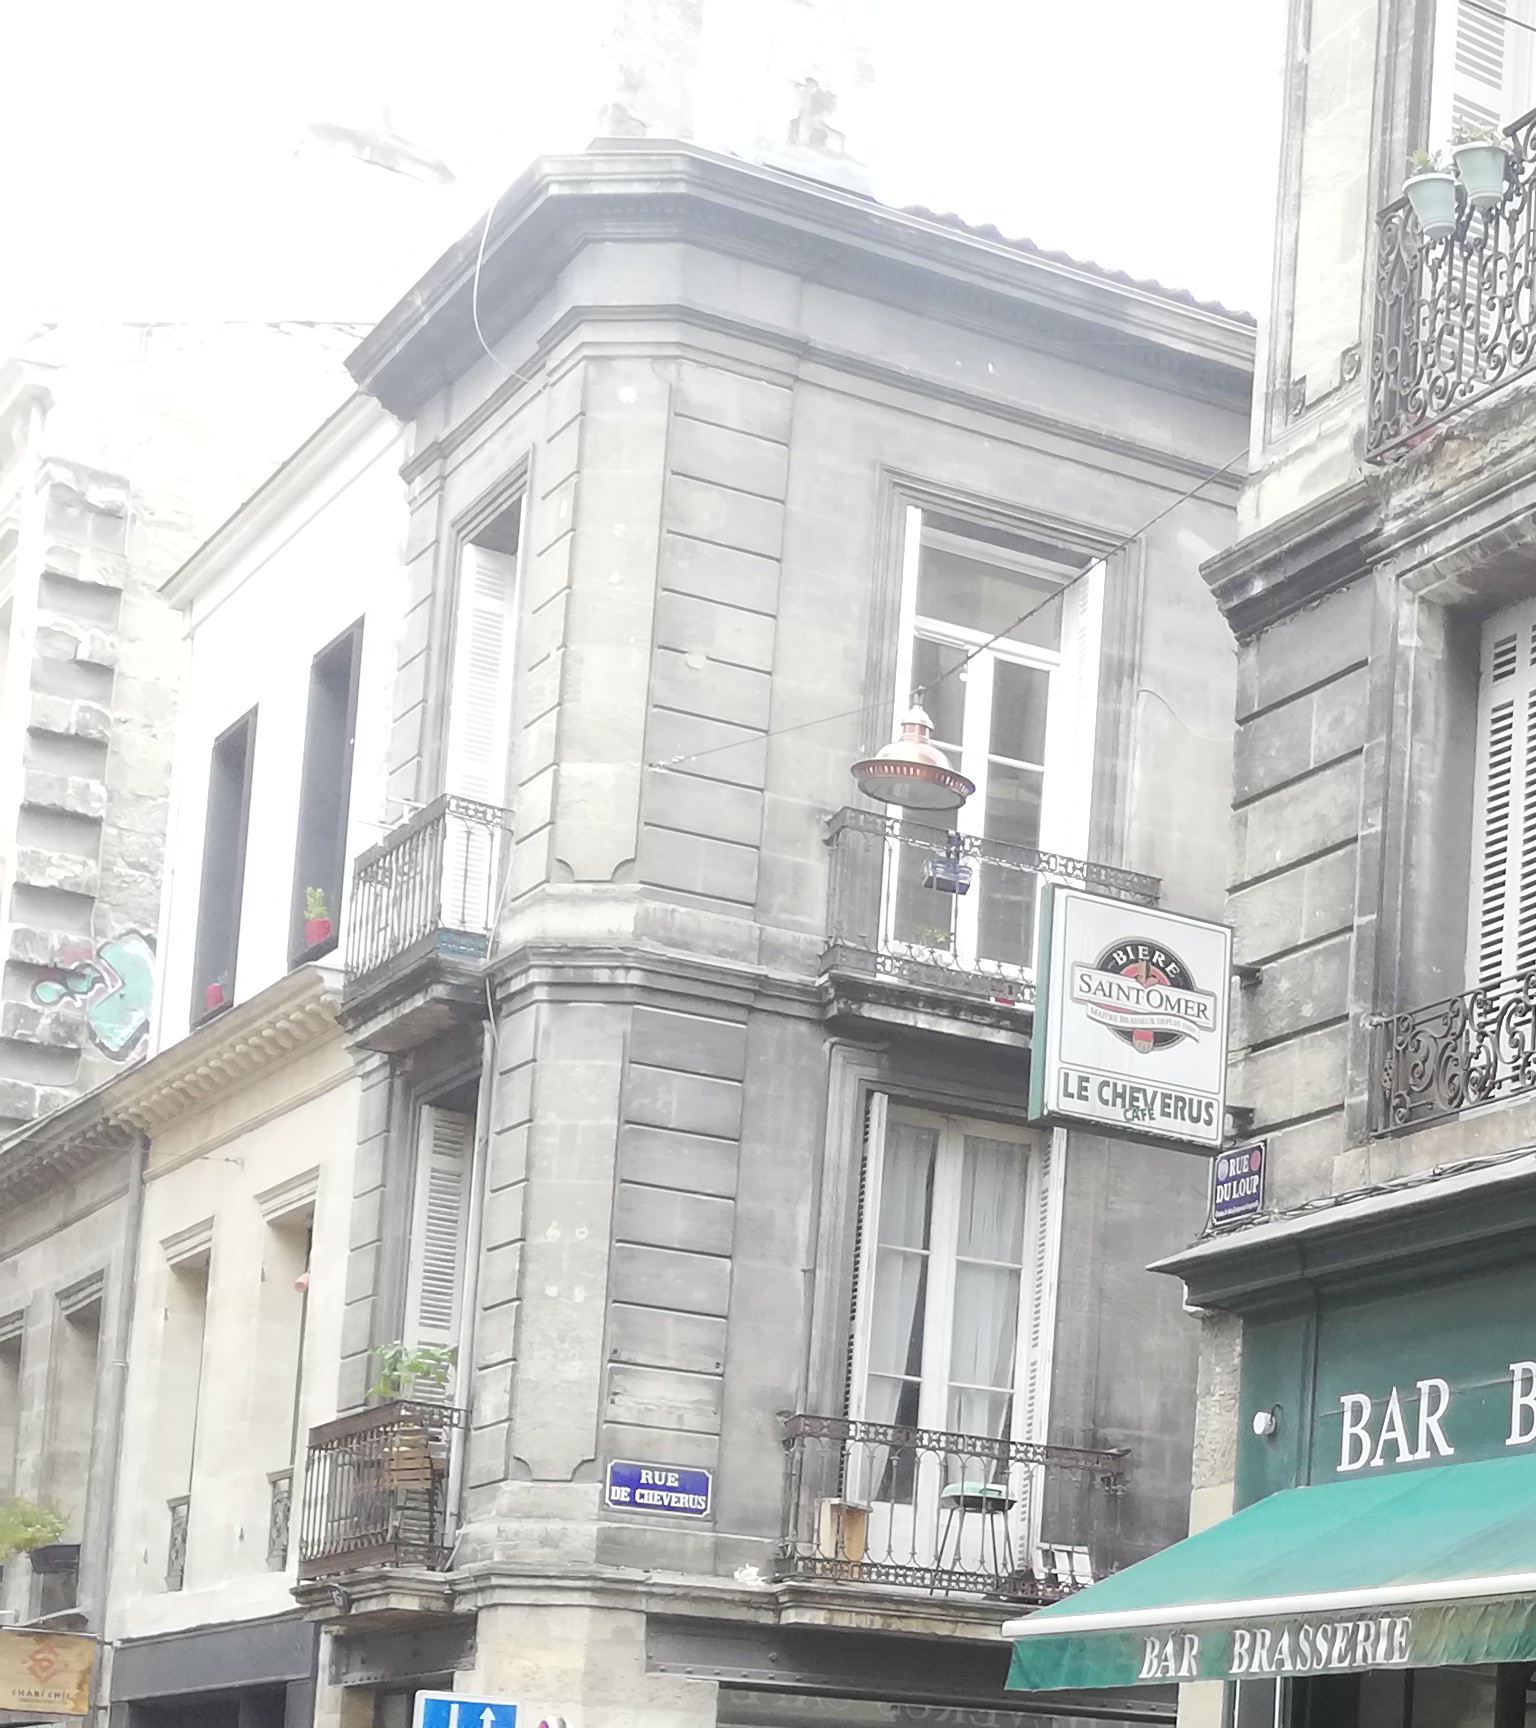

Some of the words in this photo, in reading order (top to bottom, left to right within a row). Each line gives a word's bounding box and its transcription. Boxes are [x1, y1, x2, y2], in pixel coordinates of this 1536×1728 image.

[1062, 1072, 1090, 1102] LE
[1097, 1080, 1215, 1127] CHEVERUS
[1229, 1154, 1250, 1177] RUE
[1216, 1182, 1231, 1203] DU
[1232, 1175, 1259, 1199] LOUP
[1336, 1377, 1455, 1473] BAR
[640, 1469, 679, 1487] RUE
[610, 1486, 631, 1502] DE
[634, 1488, 706, 1510] CHEVERUS
[1139, 1633, 1200, 1680] BAR
[1228, 1615, 1412, 1675] BRASSERIE
